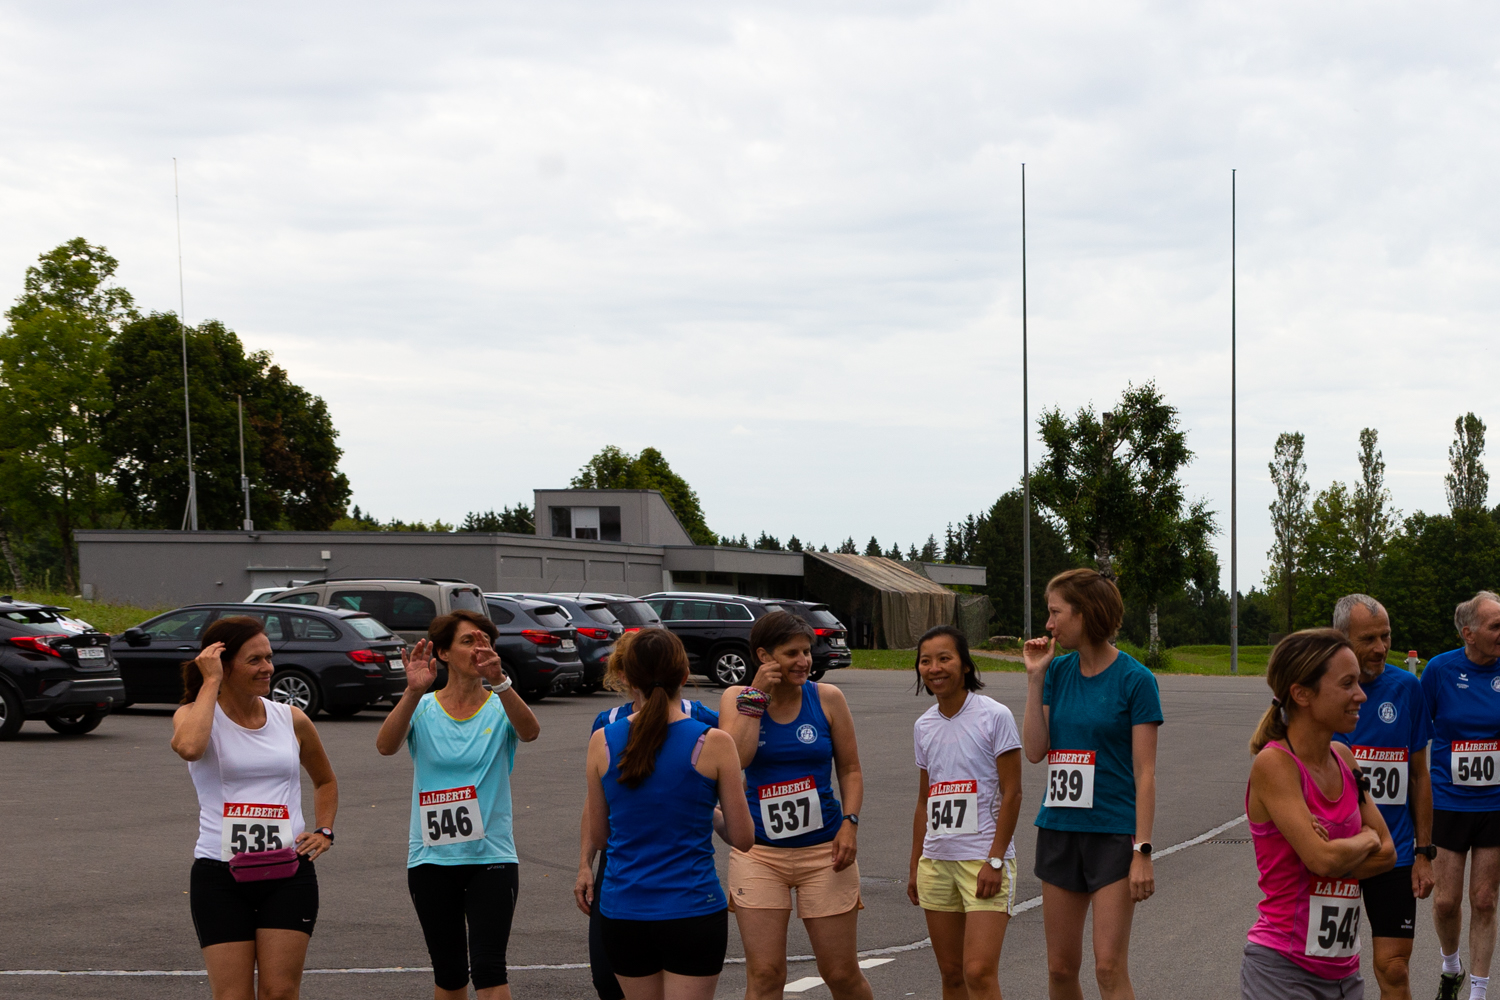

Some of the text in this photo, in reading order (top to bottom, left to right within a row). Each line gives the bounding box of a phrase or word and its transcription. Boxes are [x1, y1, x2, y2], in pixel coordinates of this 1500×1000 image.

[1353, 748, 1404, 761] LA LIBERTÉ
[1454, 740, 1498, 751] LA LIBERTÉ
[1056, 751, 1091, 764] LIBERTÉ
[1458, 755, 1494, 782] 540
[761, 778, 812, 799] LA LIBERTÉ
[938, 781, 973, 794] LIBERTÉ
[1050, 769, 1084, 801] 539
[422, 788, 472, 805] LA LIBERTÉ
[227, 804, 285, 818] LA LIBERTÉ
[768, 797, 811, 834] 537
[932, 799, 968, 831] 547
[427, 806, 473, 841] 546
[231, 823, 283, 855] 535
[1314, 881, 1333, 895] LA
[1317, 905, 1360, 950] 543
